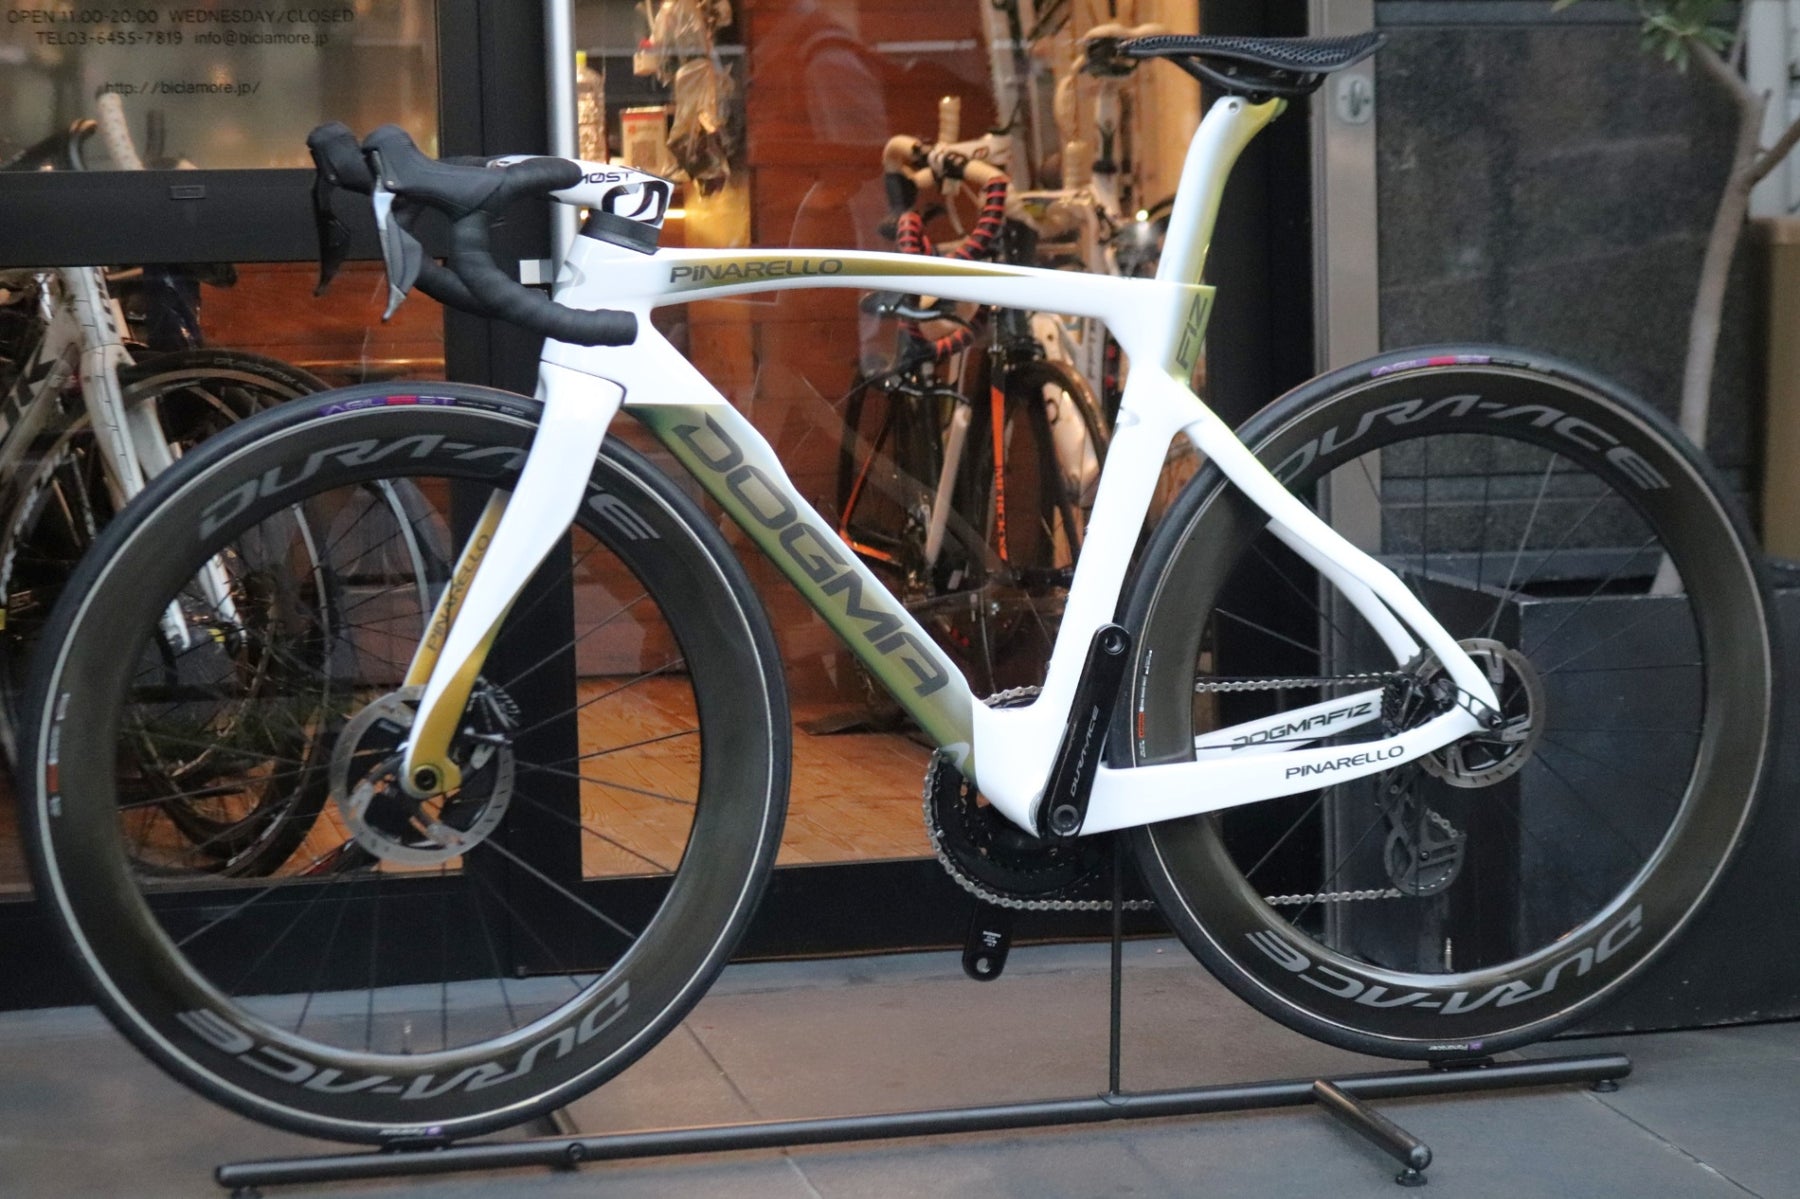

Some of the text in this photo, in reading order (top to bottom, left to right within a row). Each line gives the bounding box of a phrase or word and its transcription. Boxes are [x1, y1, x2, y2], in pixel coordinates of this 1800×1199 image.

[7, 10, 55, 24] OPEN
[169, 9, 354, 24] WEDNESDAY/CLOSED
[36, 30, 329, 47] TEL03-6455-7819 info@biciamore.jp
[105, 80, 261, 96] http://biciamore.jp/
[670, 258, 843, 284] PINARELLO
[670, 411, 950, 698] DOGMA
[1285, 745, 1404, 780] PINARELLO
[1246, 904, 1643, 1015] DURA-ACE
[175, 981, 632, 1101] DURA-ACE
